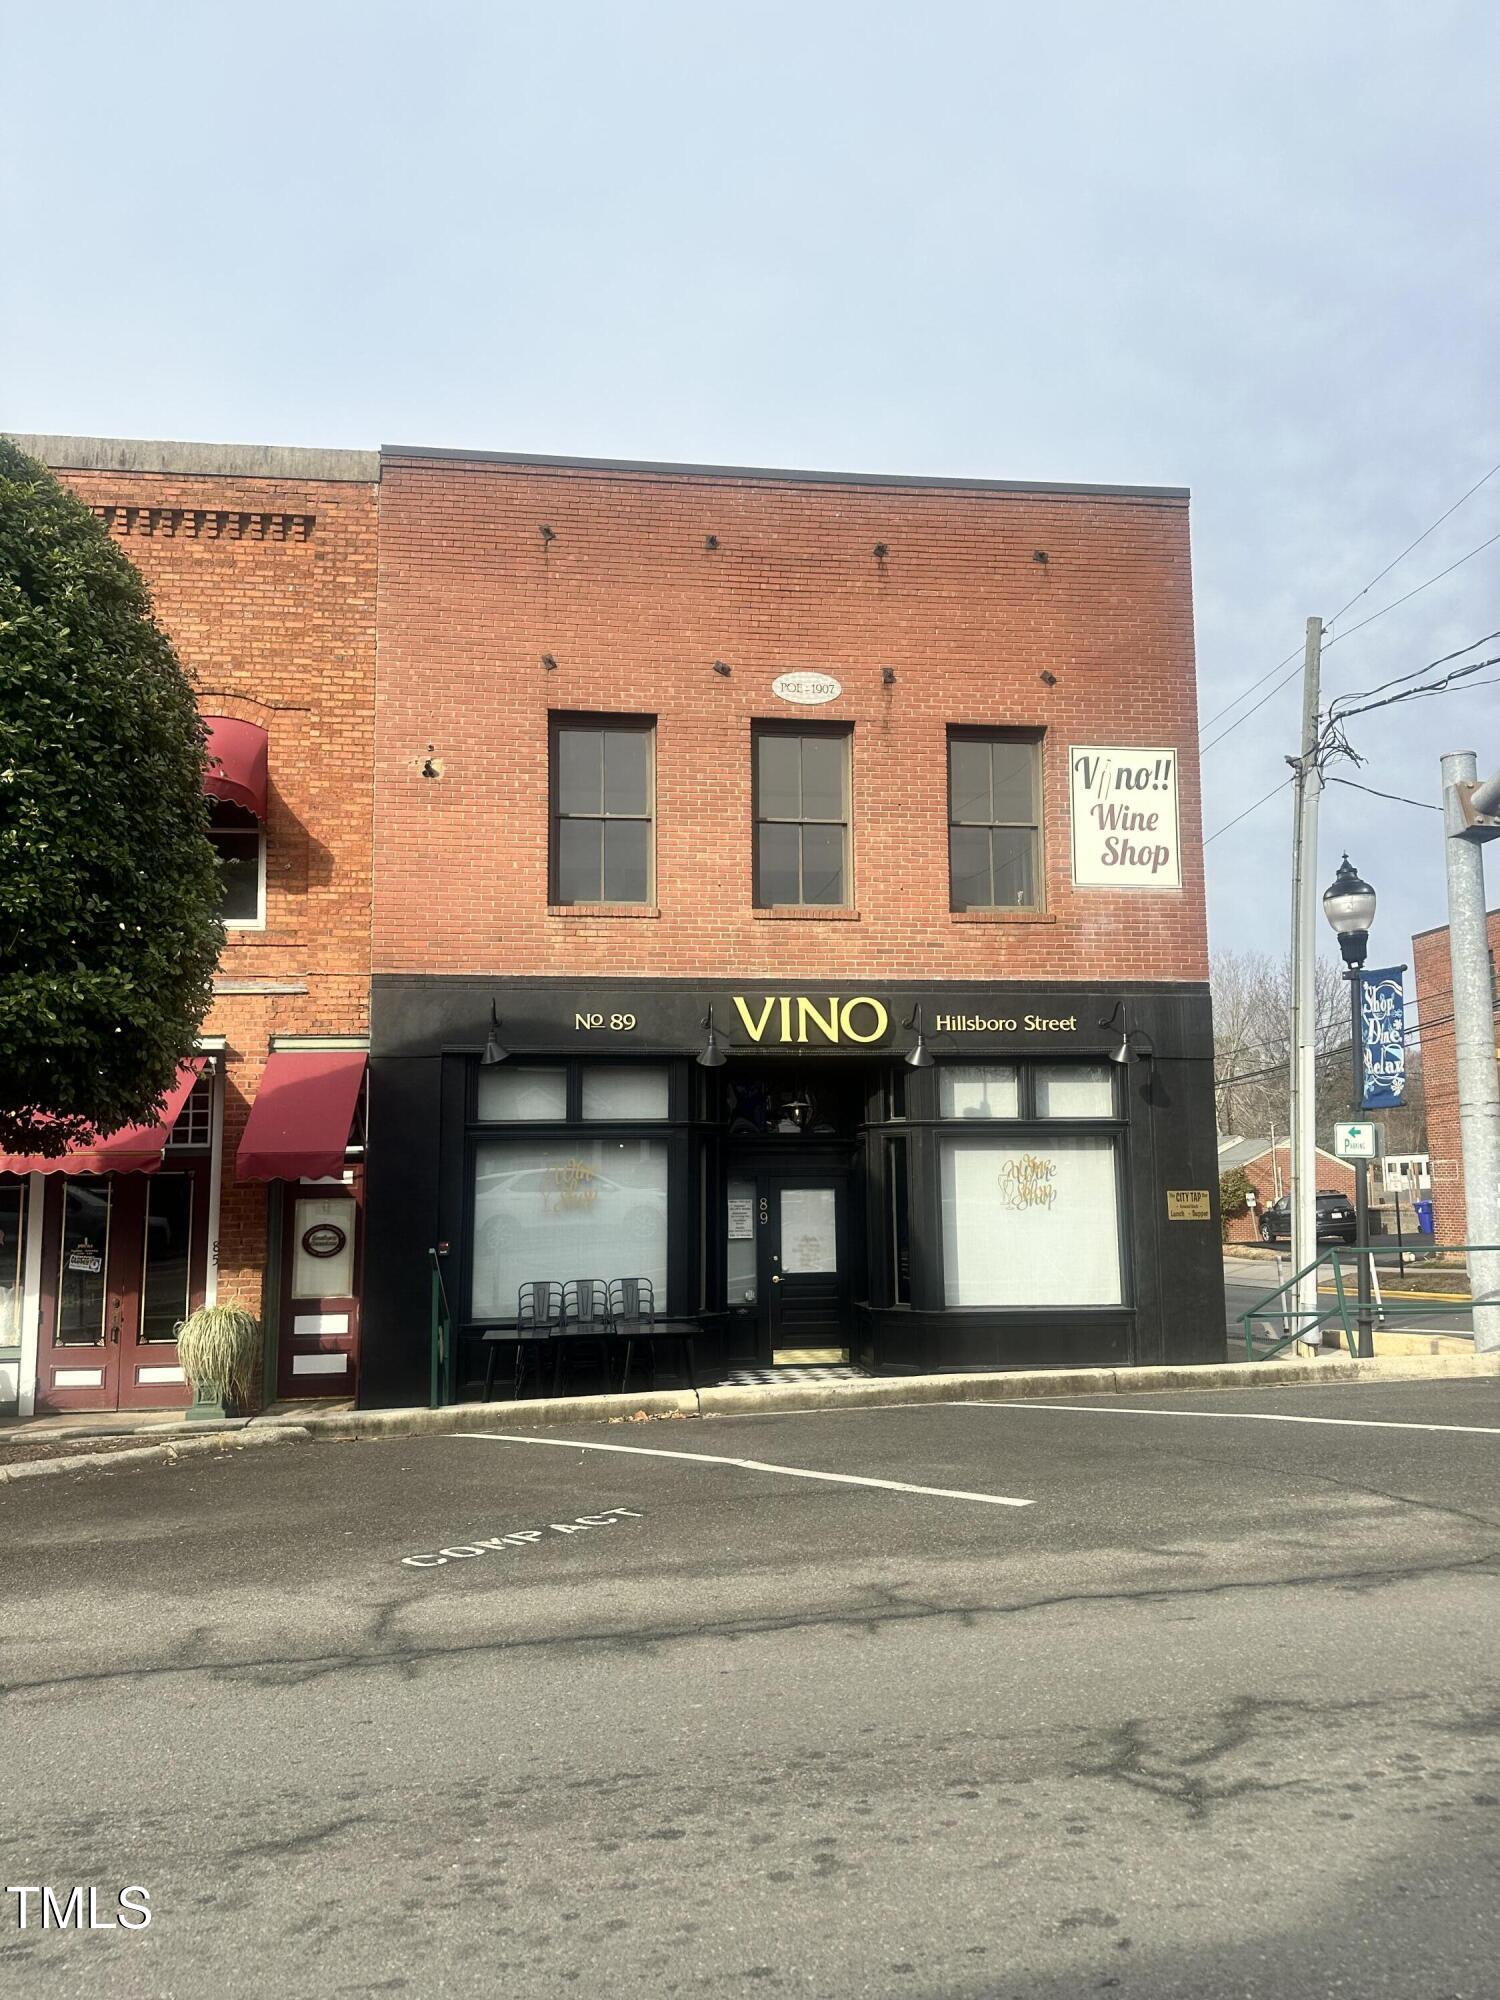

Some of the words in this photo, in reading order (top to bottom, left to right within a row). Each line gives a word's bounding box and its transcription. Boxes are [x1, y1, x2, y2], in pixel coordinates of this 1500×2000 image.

[1090, 803, 1159, 831] Wine
[1101, 836, 1170, 874] Shop
[610, 1013, 637, 1030] 89
[733, 996, 889, 1043] VINO
[936, 1014, 1018, 1032] Hillsboro
[1024, 1014, 1077, 1032] Street
[759, 1197, 768, 1225] 89
[1175, 1191, 1190, 1203] CITY
[1190, 1191, 1202, 1203] TAP
